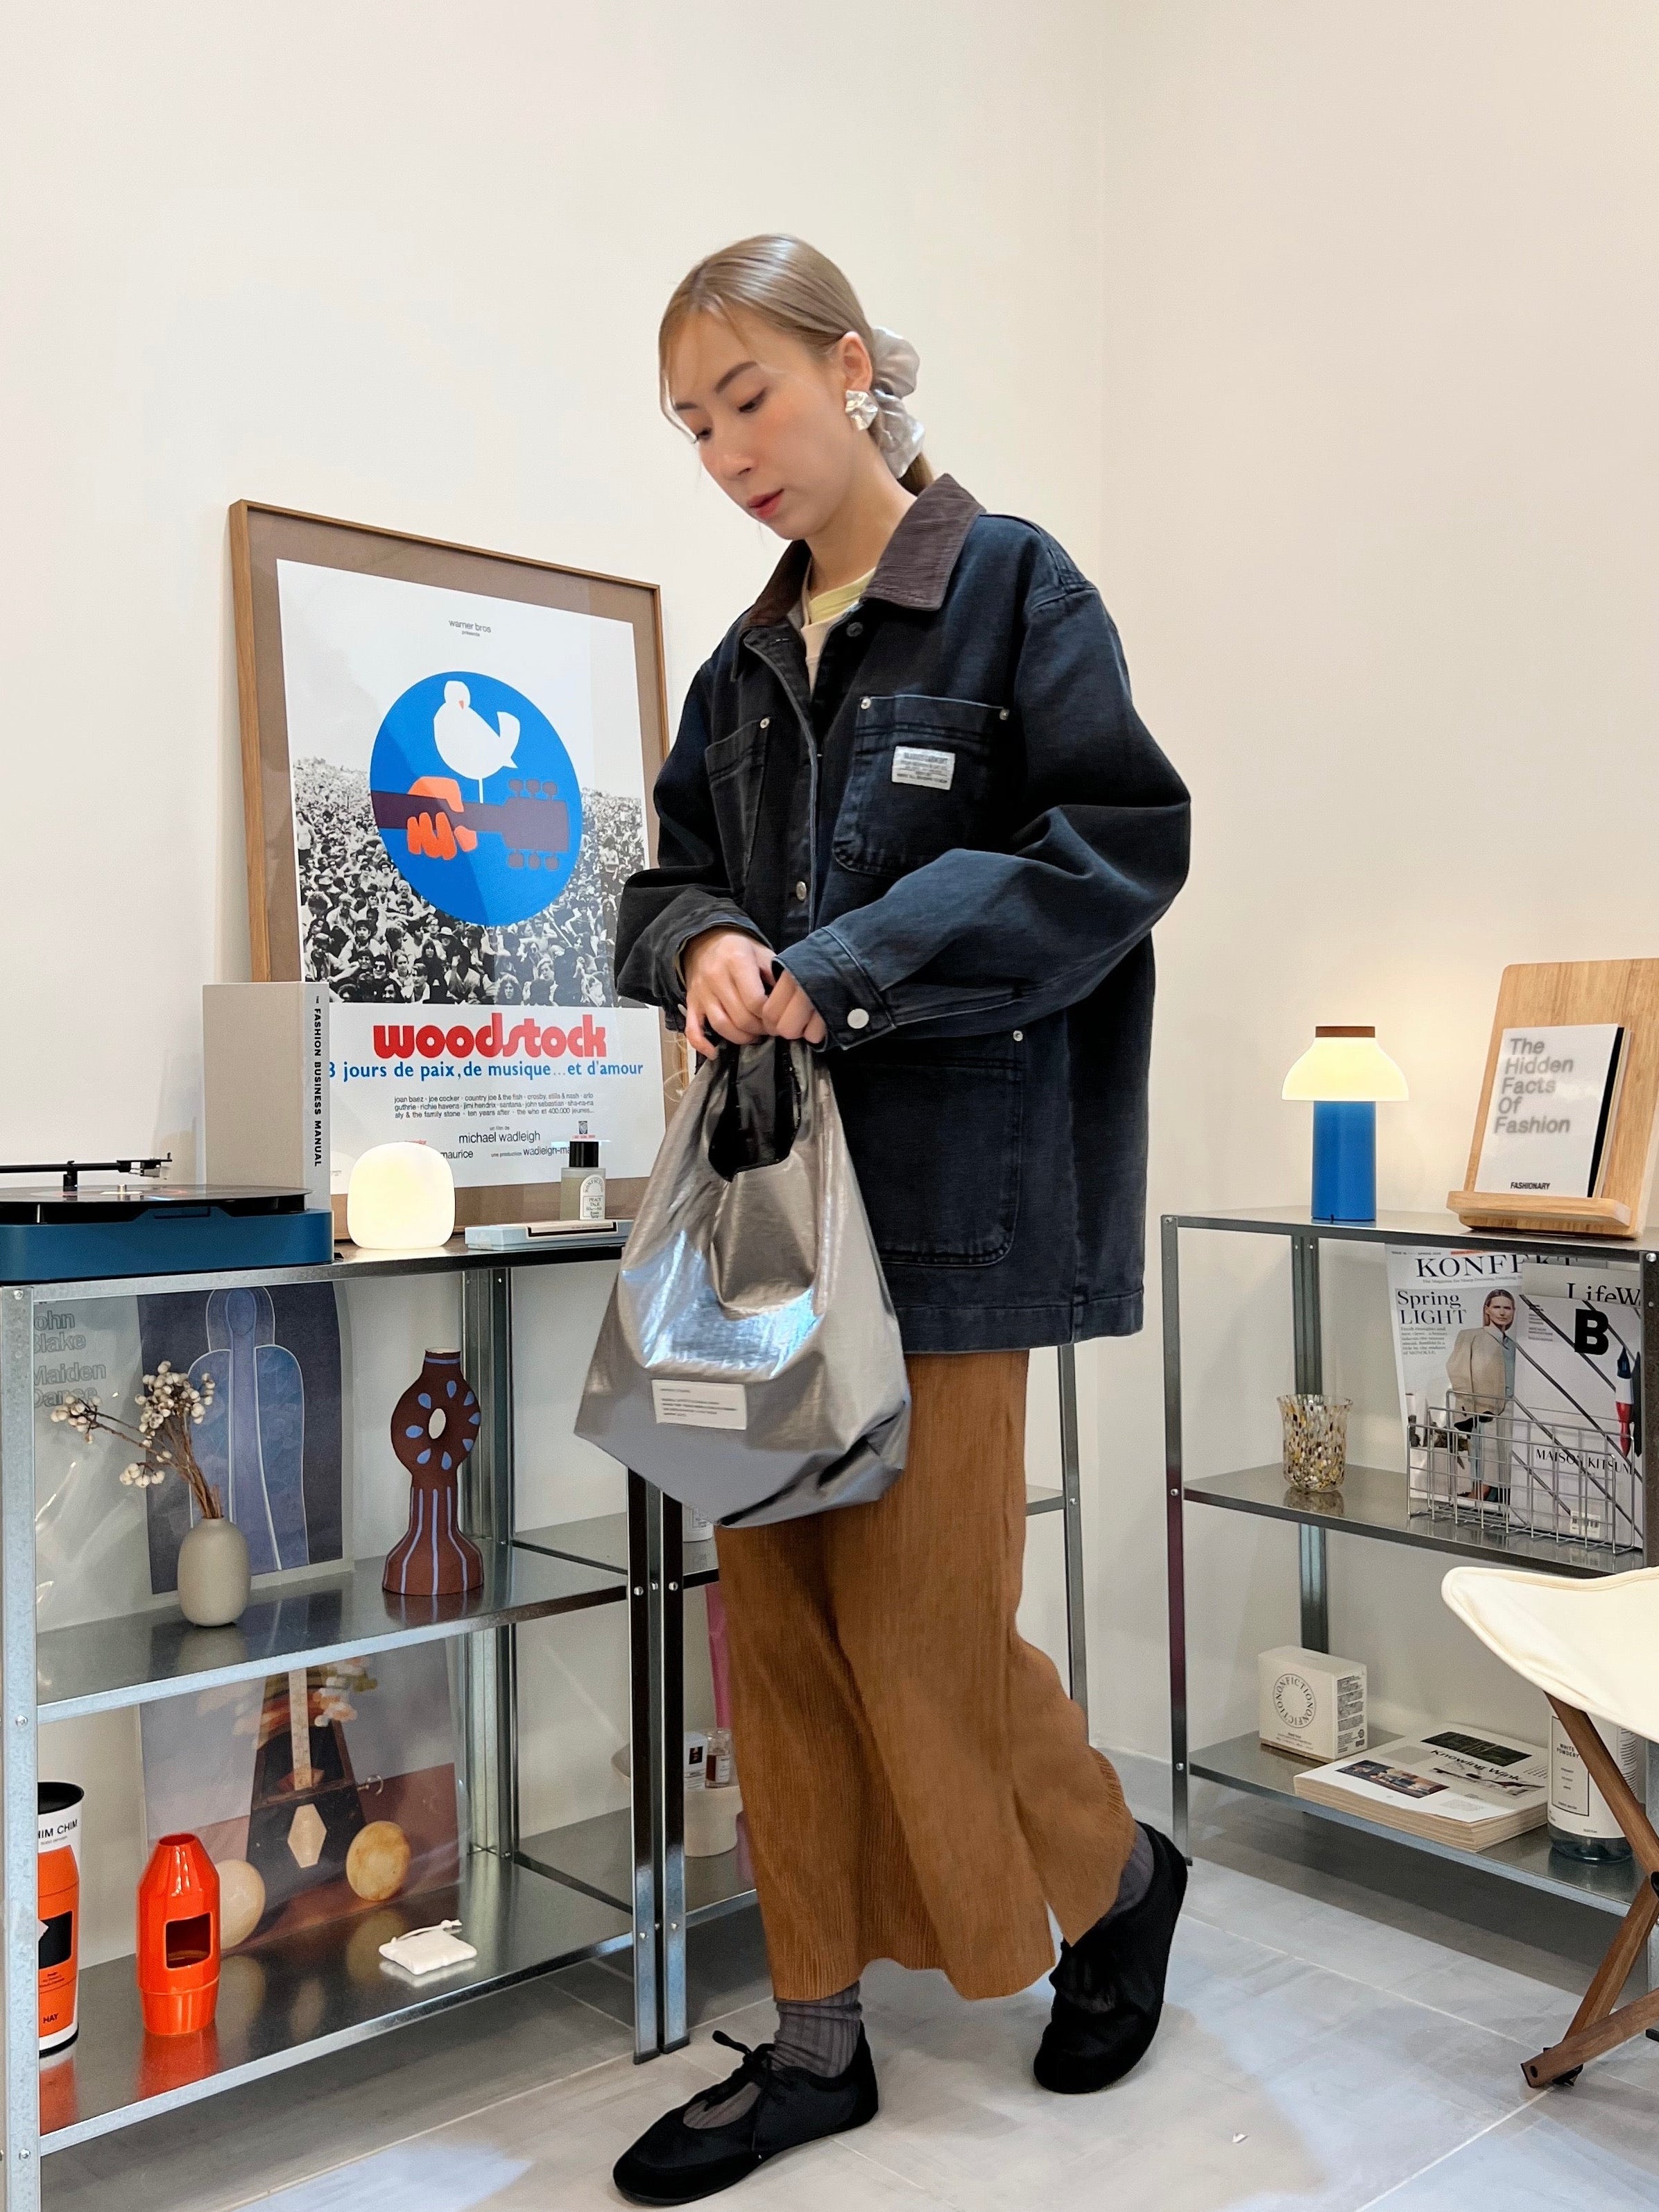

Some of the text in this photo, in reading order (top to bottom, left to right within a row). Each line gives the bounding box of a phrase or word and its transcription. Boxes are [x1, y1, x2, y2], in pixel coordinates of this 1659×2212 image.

[475, 623, 492, 633] bros
[372, 1012, 607, 1058] woodstock
[1511, 1038, 1545, 1055] The
[329, 1061, 336, 1077] 3
[343, 1061, 387, 1082] jours
[394, 1061, 414, 1077] de
[587, 1061, 644, 1075] d'amour
[1505, 1058, 1574, 1075] Hidden
[1502, 1077, 1556, 1095] Facts
[1498, 1097, 1522, 1115] Of
[1494, 1116, 1571, 1134] Fashion
[459, 1130, 540, 1143] michael wadleigh
[1511, 1181, 1551, 1190] FASHIONARY
[1416, 1253, 1578, 1278] KONFE
[1398, 1289, 1461, 1310] Spring
[1567, 1283, 1640, 1306] LifeW
[33, 1310, 76, 1331] ohn
[1400, 1309, 1467, 1324] LIGHT
[1574, 1308, 1609, 1355] B
[33, 1331, 86, 1353] Blake
[33, 1362, 107, 1386] Maiden
[1431, 1749, 1487, 1769] Knowing
[1488, 1768, 1520, 1781] Wink
[57, 1819, 78, 1835] CHIM
[43, 2013, 59, 2023] HAY
